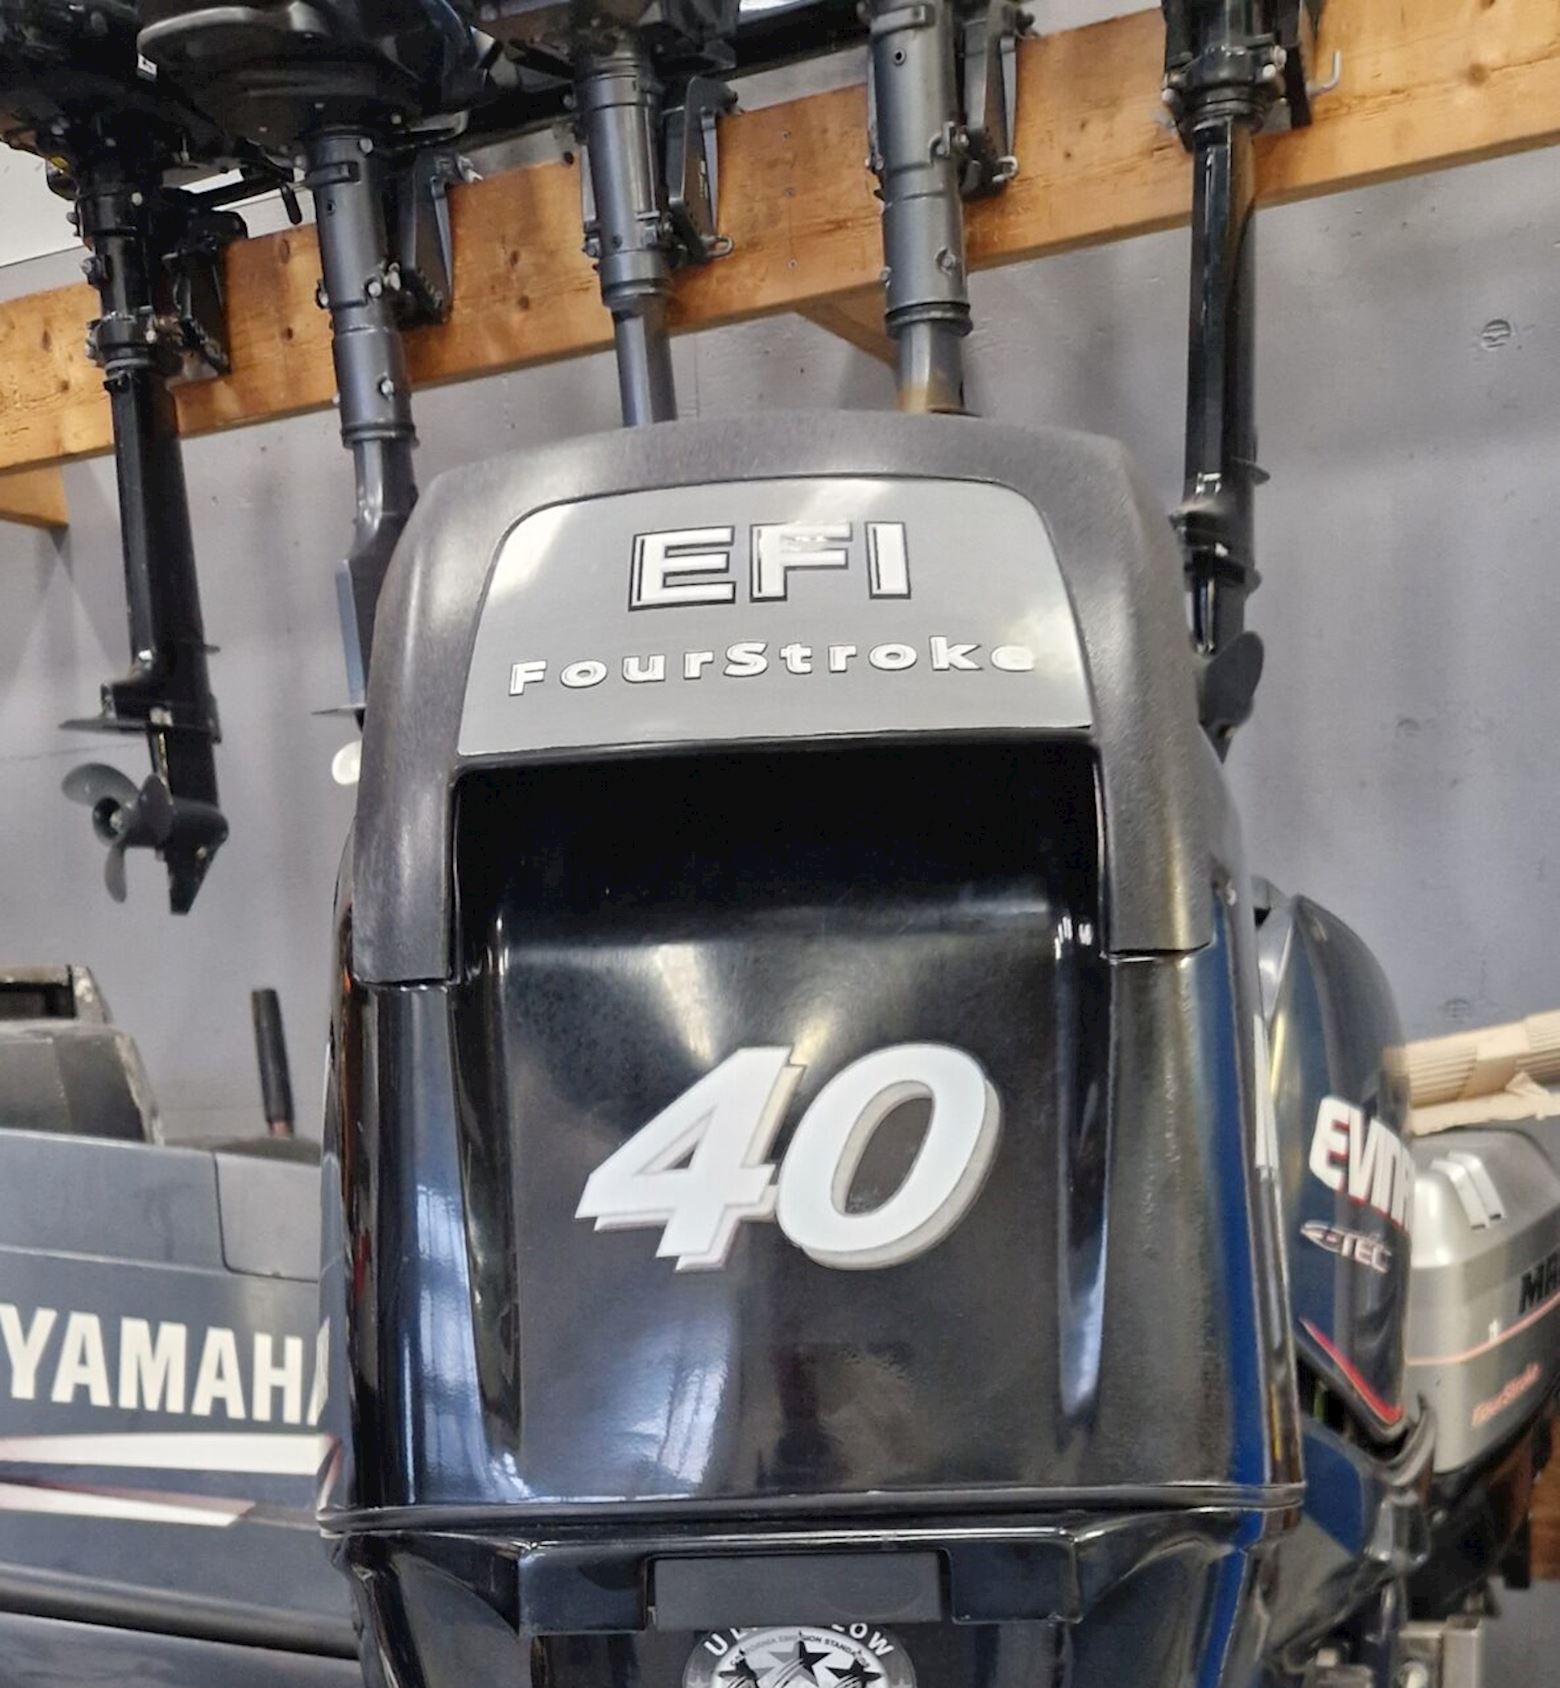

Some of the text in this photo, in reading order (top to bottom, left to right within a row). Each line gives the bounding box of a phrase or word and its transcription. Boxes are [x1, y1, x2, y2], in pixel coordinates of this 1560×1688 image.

[628, 520, 912, 612] EFI
[508, 635, 1036, 697] FourStroke
[574, 1042, 1002, 1273] 40
